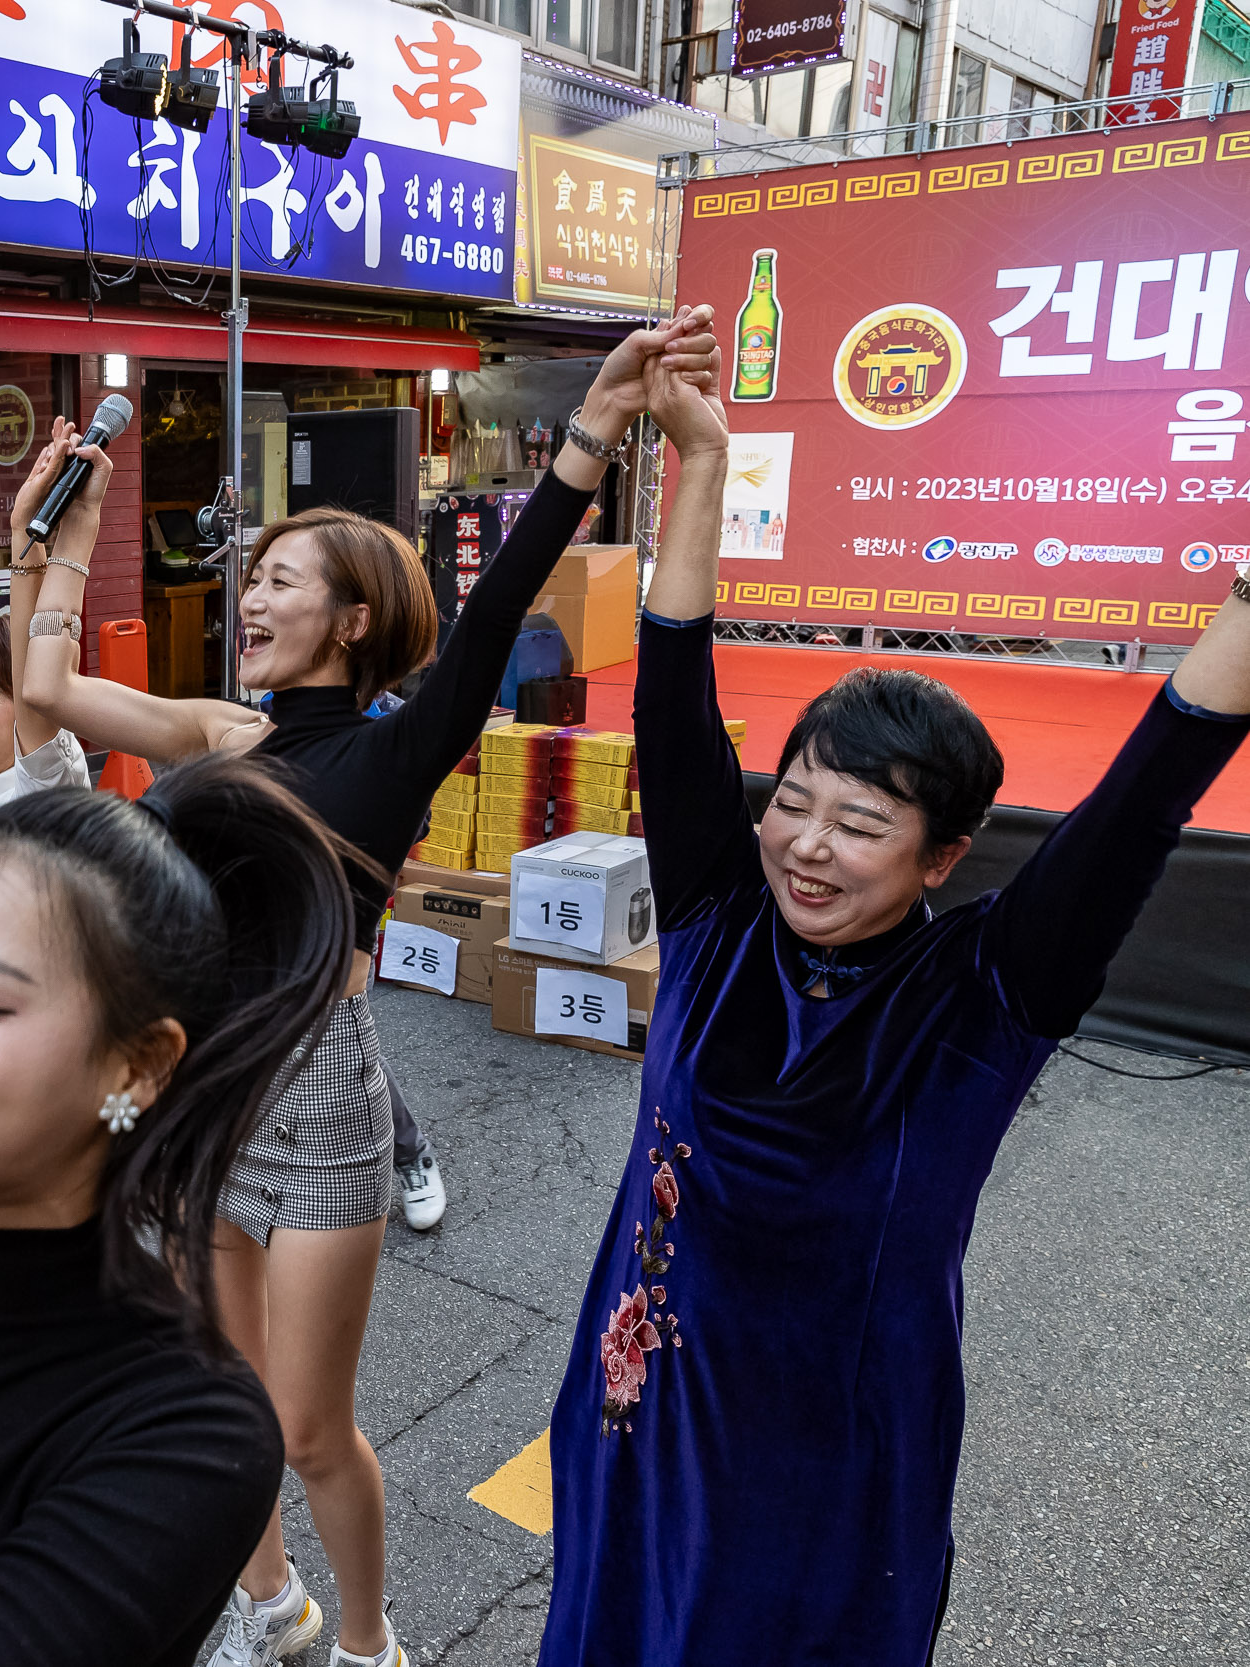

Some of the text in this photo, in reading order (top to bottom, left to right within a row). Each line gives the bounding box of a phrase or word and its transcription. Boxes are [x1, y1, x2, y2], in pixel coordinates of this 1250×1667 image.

[746, 14, 833, 43] 02-6405-8786
[1131, 18, 1180, 34] Fried Food
[400, 233, 504, 275] 467-6880
[988, 249, 1250, 378] 건대
[738, 350, 775, 361] TSINGTAO
[1167, 389, 1250, 461] 음
[850, 476, 894, 500] 일시
[915, 476, 1168, 504] 2023년10월18일(수)
[852, 536, 907, 558] 협찬사
[959, 544, 1016, 559] 광진구
[560, 868, 600, 880] CUCKOO
[437, 918, 466, 929] Shinil
[540, 900, 583, 931] 1등
[402, 945, 440, 974] 2등
[498, 953, 510, 963] LG
[559, 993, 606, 1024] 3등
